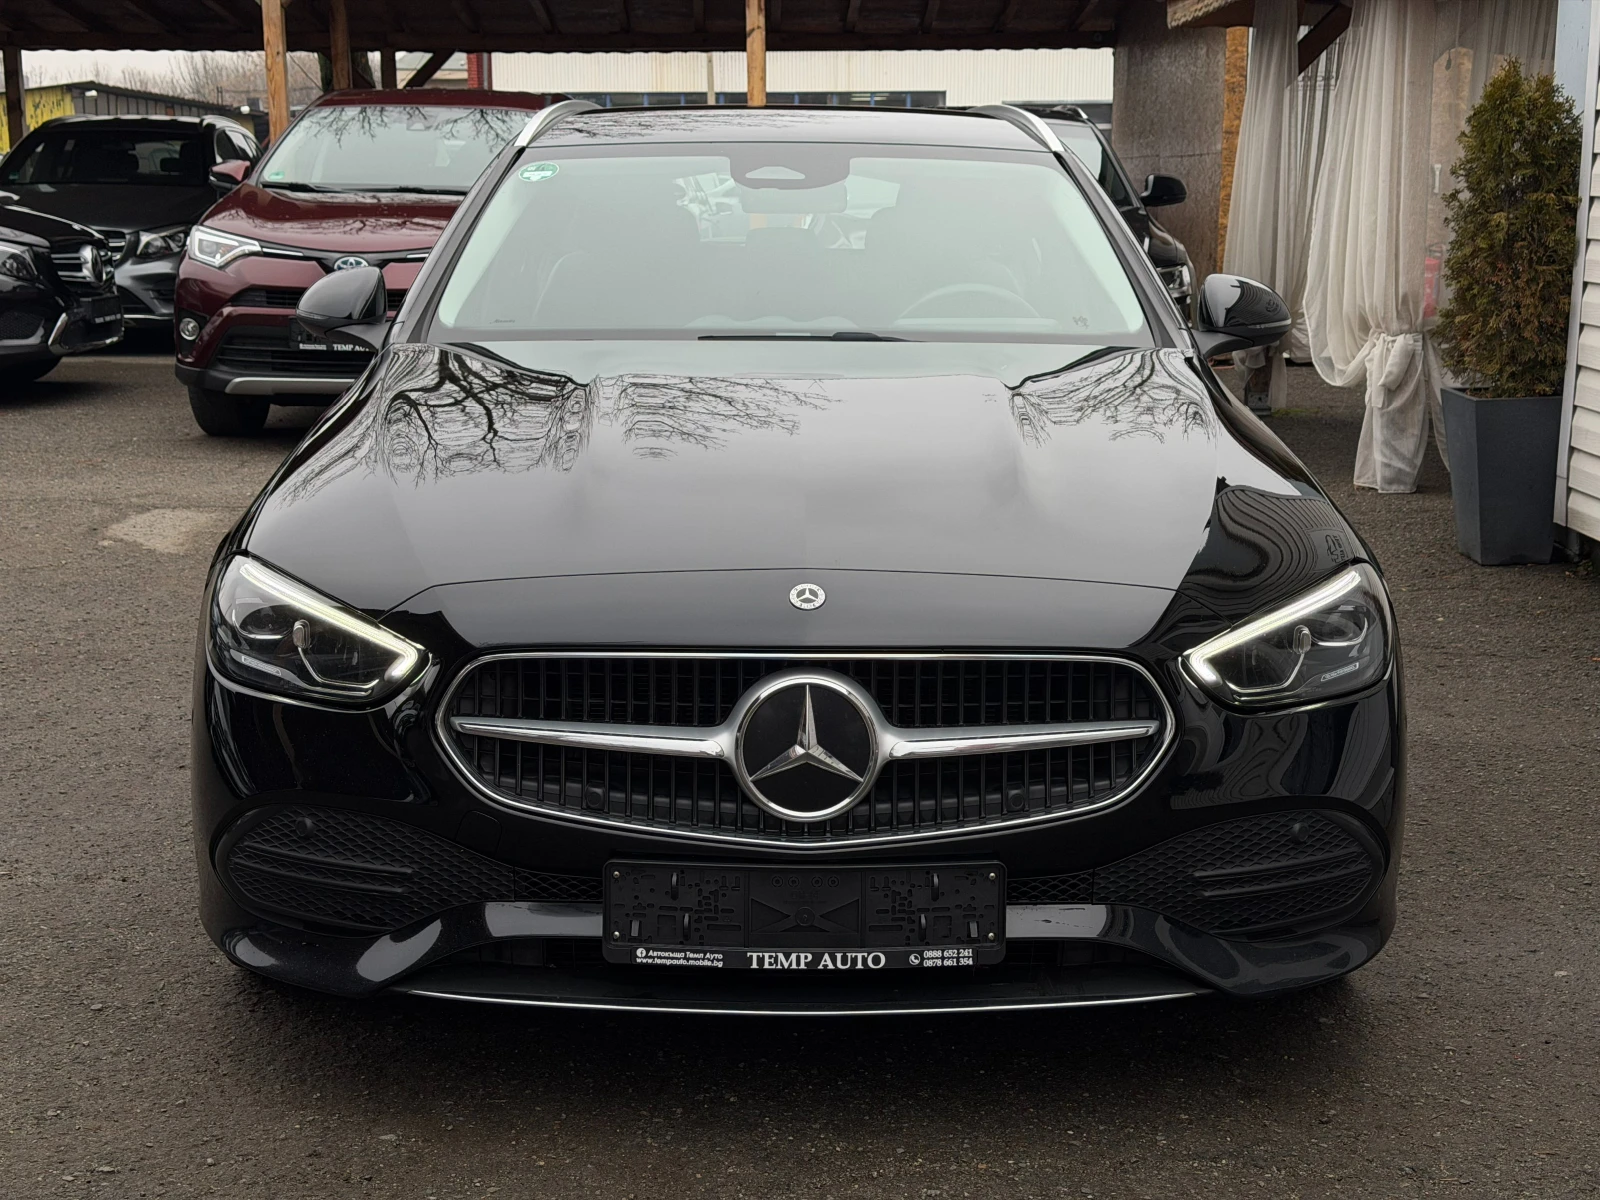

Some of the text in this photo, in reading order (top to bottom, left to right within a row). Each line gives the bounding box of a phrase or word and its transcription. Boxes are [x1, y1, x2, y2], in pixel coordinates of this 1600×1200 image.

[648, 949, 685, 958] Автокъща
[685, 951, 704, 959] Темп
[705, 952, 723, 960] Ауто
[923, 948, 974, 958] 0888 652 241
[636, 957, 723, 967] www.tempauto.mobile.bg
[747, 952, 886, 969] TEMP AUTO
[923, 957, 974, 967] 0878 661 354
